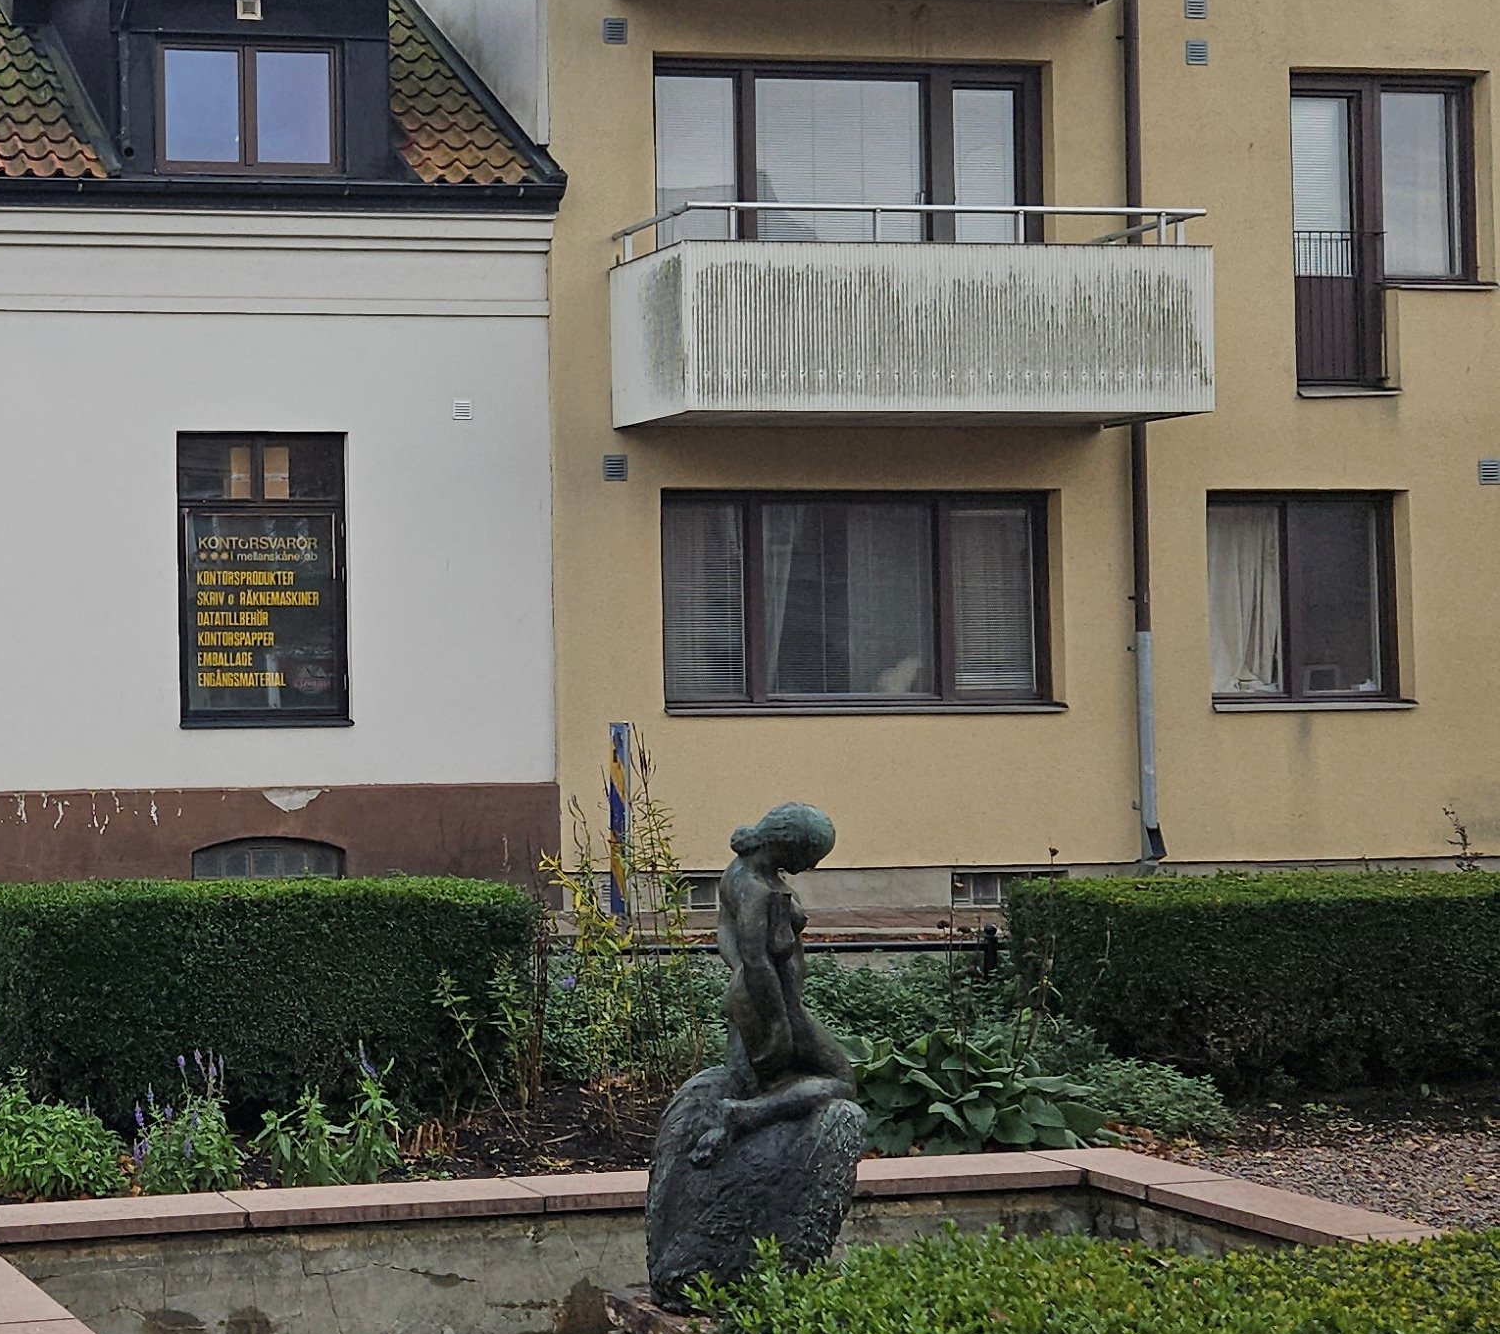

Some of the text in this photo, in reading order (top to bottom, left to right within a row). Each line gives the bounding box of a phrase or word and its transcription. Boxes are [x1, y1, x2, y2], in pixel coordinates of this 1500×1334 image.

[198, 536, 318, 550] KONTORSVAROR
[236, 550, 300, 562] mellanskåne
[196, 571, 294, 586] KONTORSPRODUKTER
[197, 591, 225, 606] SKRIV
[239, 589, 319, 606] RÄKNEMASKINER
[197, 610, 269, 626] DATATILLBEHÖR
[197, 632, 274, 646] KONTORSPAPPER
[197, 652, 253, 667] EMBALLAGE
[197, 669, 286, 687] ENGÅNGSMATERIAL
